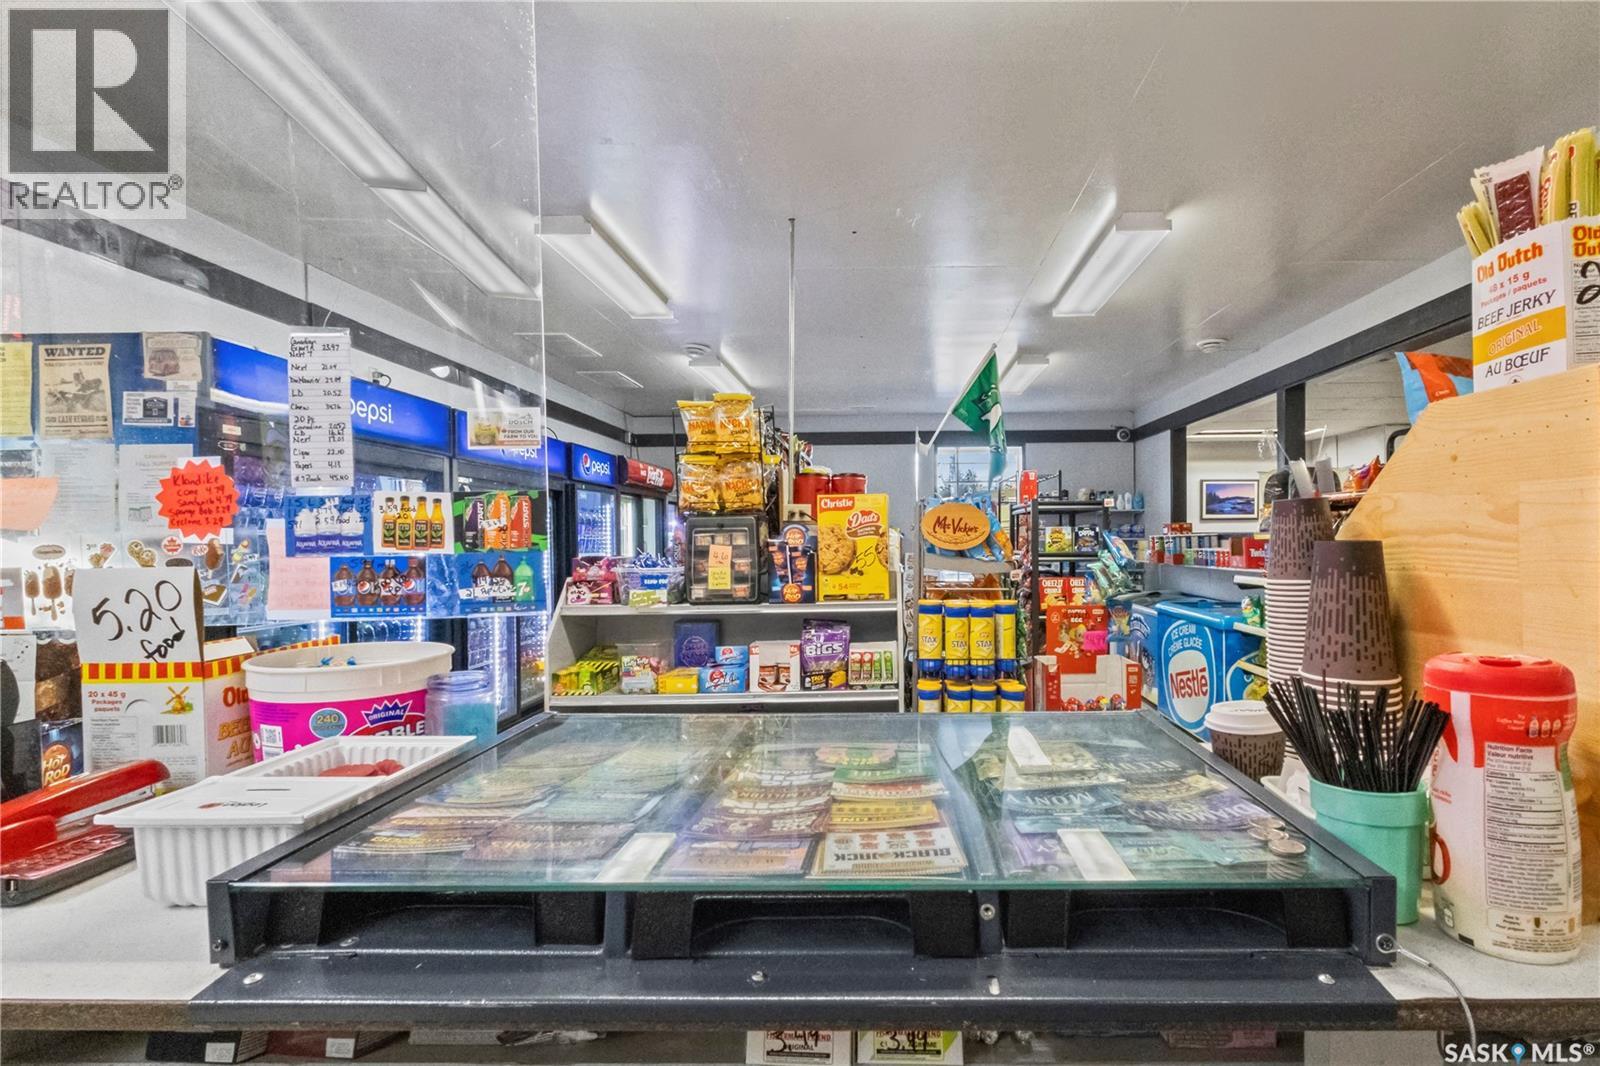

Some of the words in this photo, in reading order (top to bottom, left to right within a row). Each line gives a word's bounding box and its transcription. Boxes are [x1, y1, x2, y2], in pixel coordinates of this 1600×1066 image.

[1477, 262, 1495, 284] Old
[1497, 242, 1544, 273] Dutch
[1508, 275, 1519, 285] 15
[1523, 271, 1530, 281] g
[1513, 277, 1547, 295] paquets
[1477, 308, 1504, 330] BEEF
[1506, 289, 1556, 318] JERKY
[1488, 320, 1542, 355] ORIGINAL
[44, 347, 106, 357] WANTED
[1485, 361, 1502, 378] AU
[1504, 347, 1550, 372] BŒUF
[591, 459, 611, 477] pepsi
[820, 498, 854, 509] Christie
[522, 500, 530, 528] START
[850, 510, 879, 529] Dad's
[91, 580, 182, 641] 5.20
[140, 616, 186, 663] food
[1171, 628, 1179, 640] ICE
[1179, 624, 1197, 635] CREAM
[317, 714, 339, 724] 240
[368, 708, 405, 721] ORIGINAL
[1487, 744, 1514, 752] Nutrition
[1487, 751, 1507, 759] Valeur
[43, 754, 67, 770] HOT
[44, 763, 70, 786] ROD
[834, 851, 880, 862] JACK
[893, 847, 951, 860] BLACK
